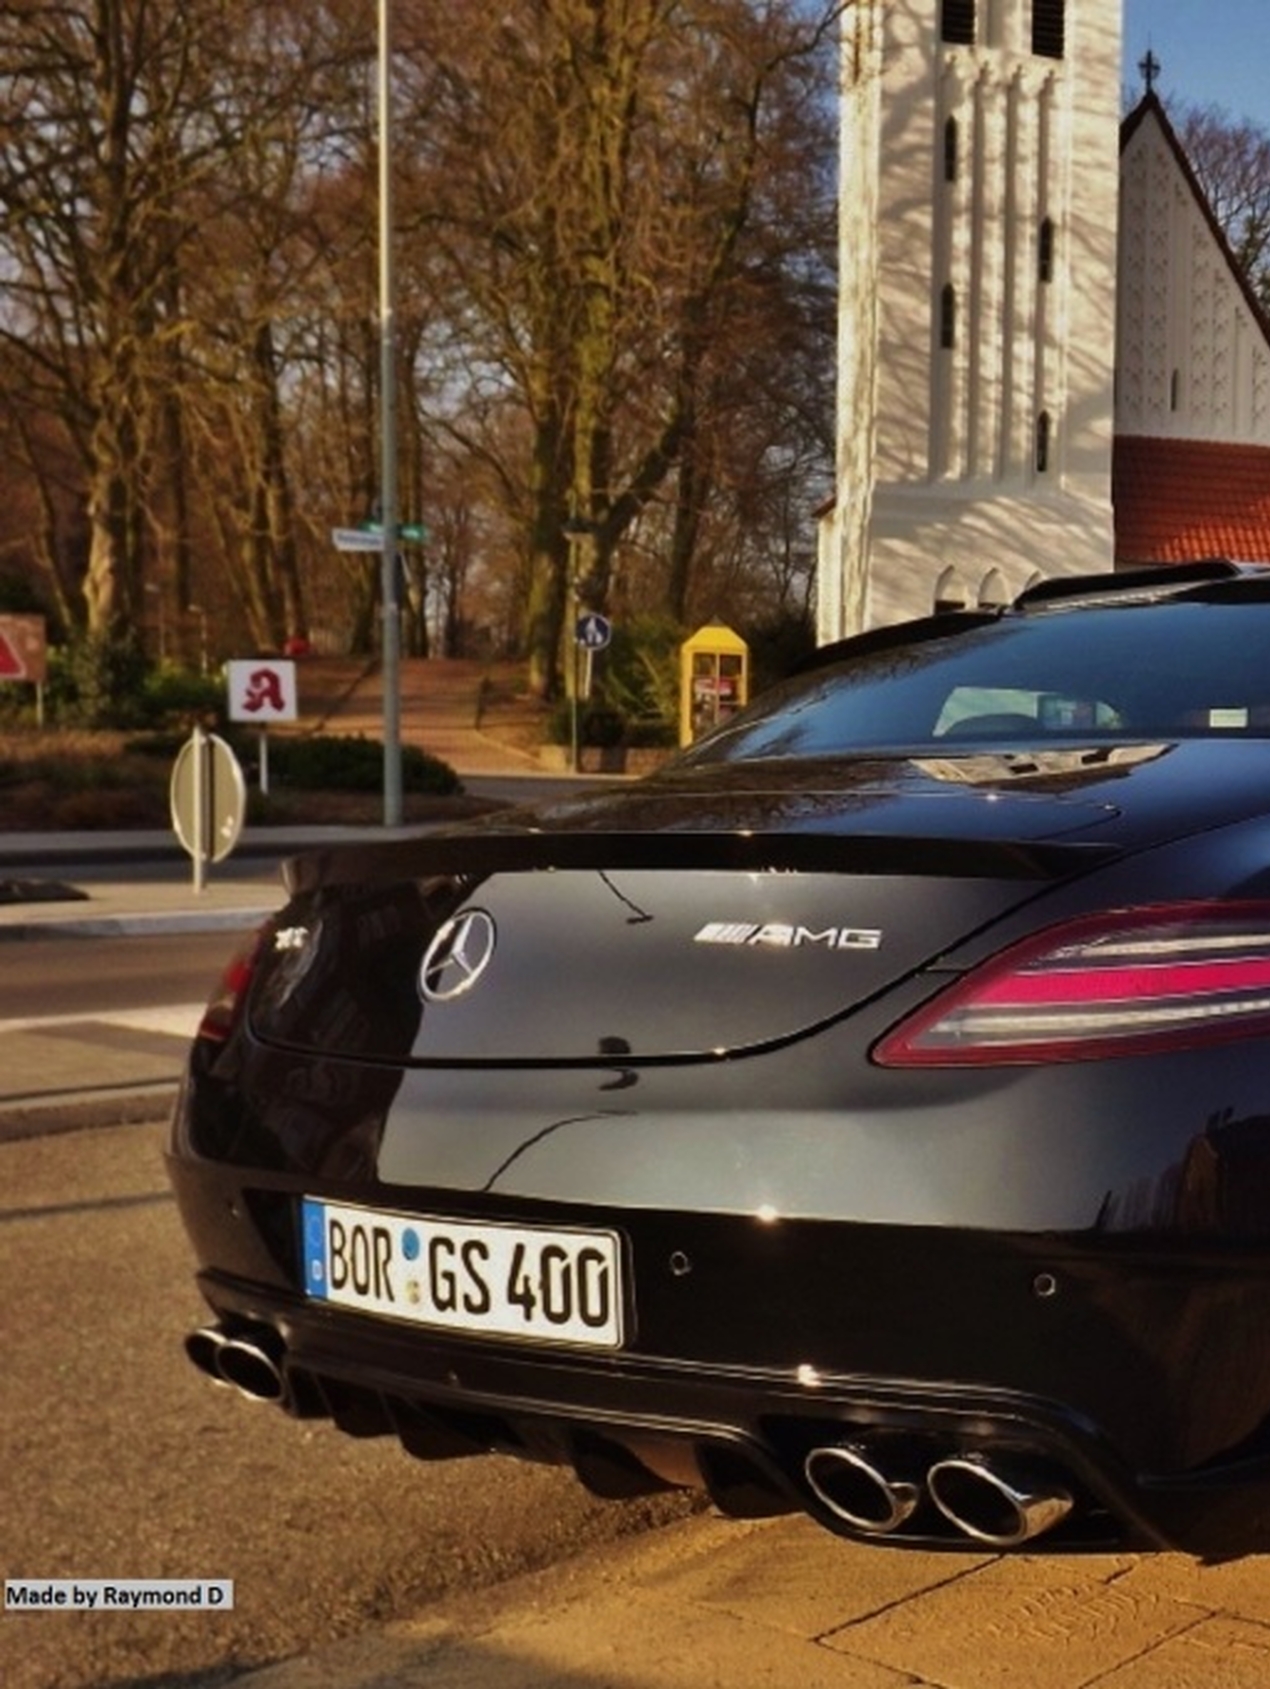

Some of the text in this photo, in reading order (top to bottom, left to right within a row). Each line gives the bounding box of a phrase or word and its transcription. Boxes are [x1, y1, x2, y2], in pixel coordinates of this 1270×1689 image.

[329, 1218, 609, 1328] BOR GS 400
